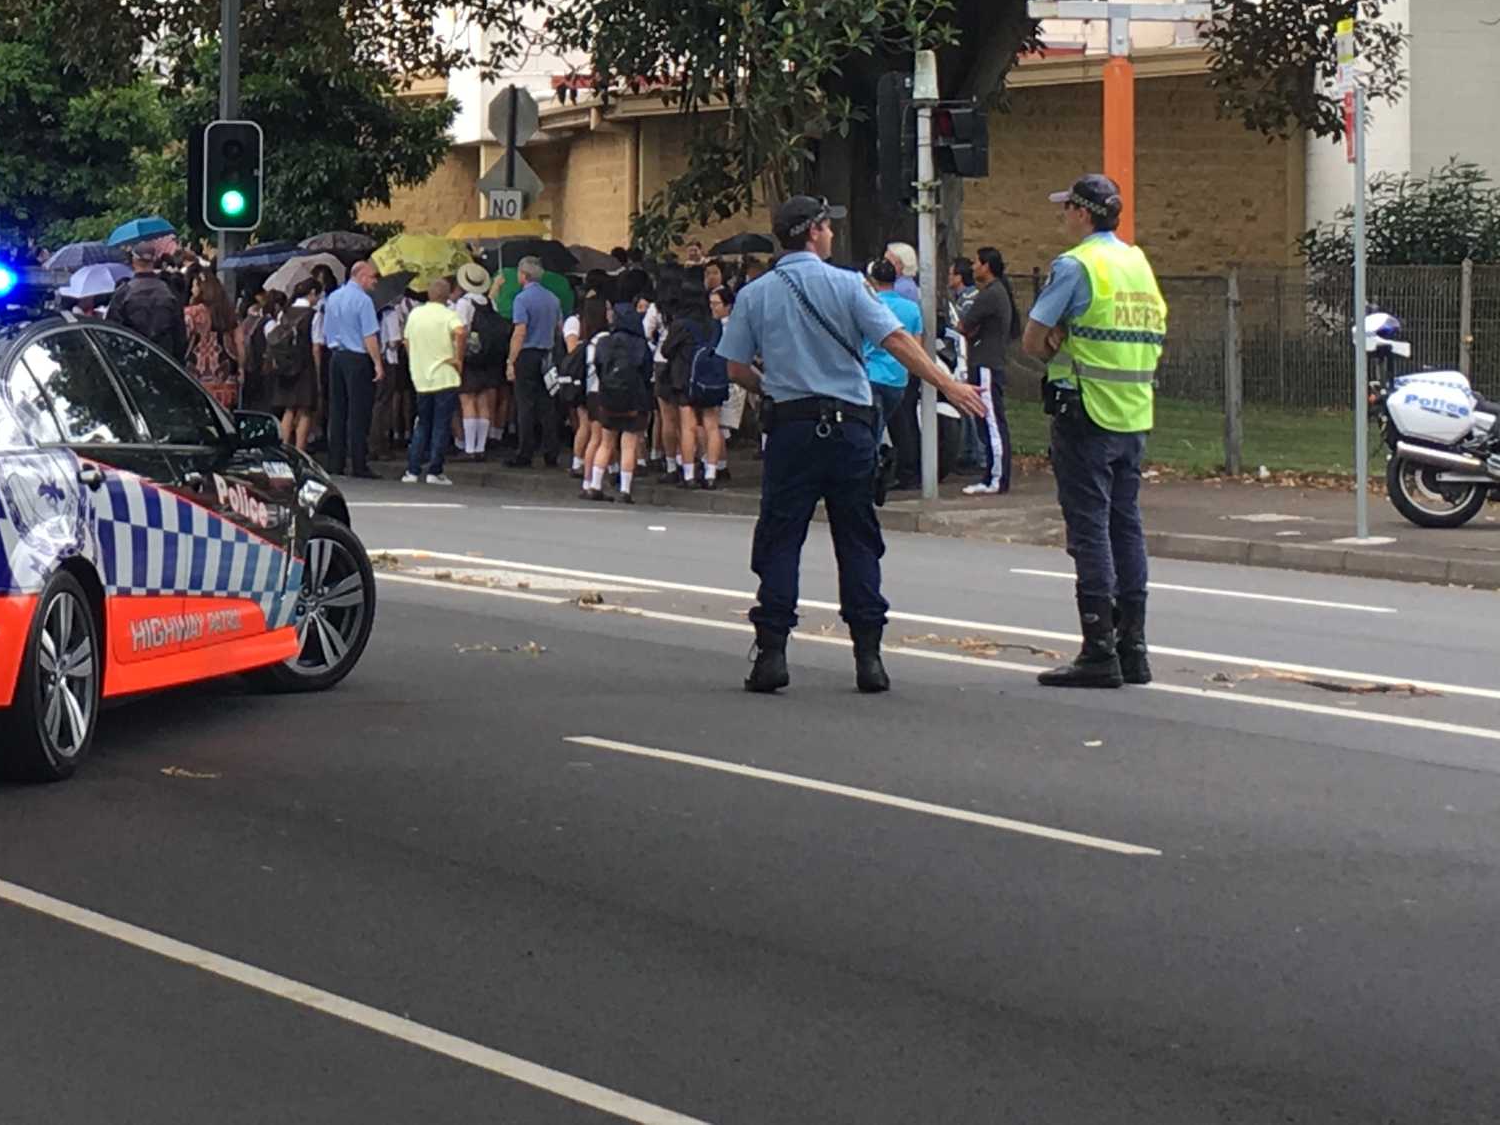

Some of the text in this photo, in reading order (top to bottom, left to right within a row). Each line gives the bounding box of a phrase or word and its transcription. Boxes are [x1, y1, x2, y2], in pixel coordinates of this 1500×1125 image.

[493, 198, 517, 218] NO
[1404, 394, 1469, 417] Police
[213, 472, 268, 528] Police
[130, 613, 204, 652] HIGHWAY
